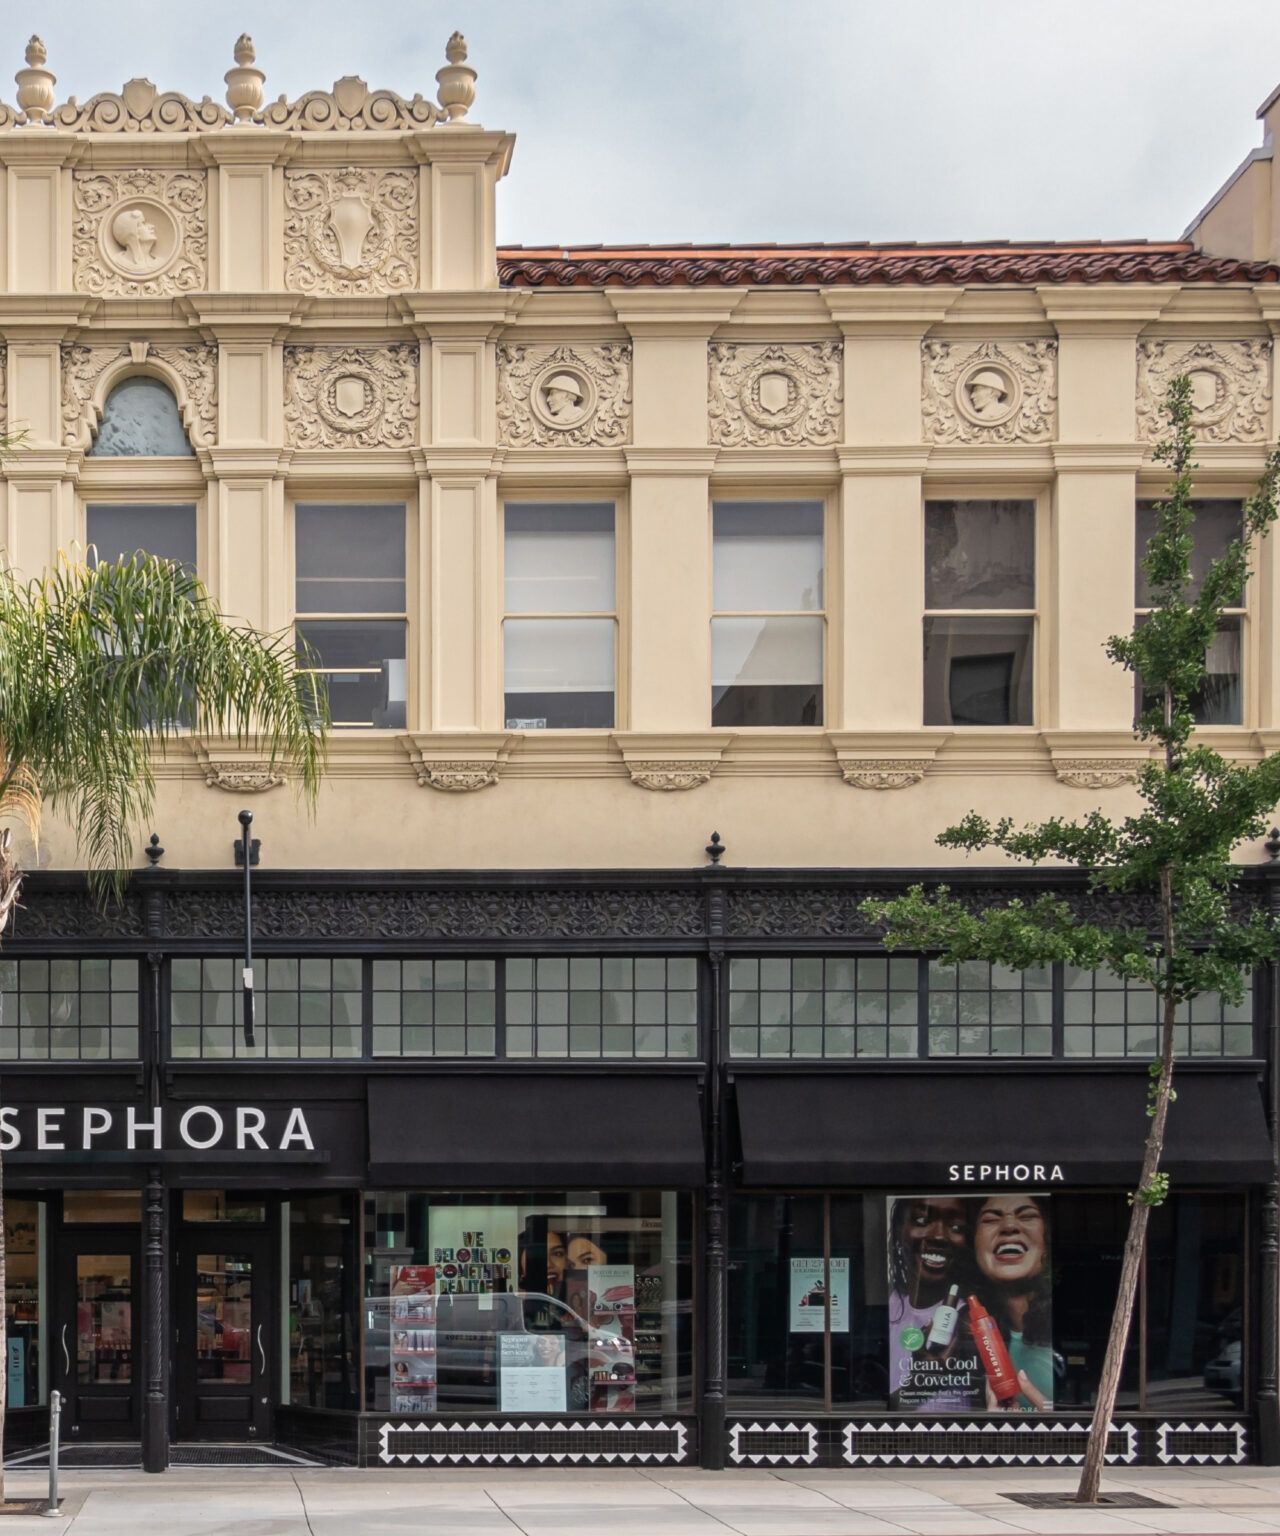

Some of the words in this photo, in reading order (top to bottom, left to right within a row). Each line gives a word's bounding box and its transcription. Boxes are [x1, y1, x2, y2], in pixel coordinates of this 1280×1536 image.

[0, 1104, 315, 1151] SEPHORA
[948, 1164, 1065, 1181] SEPHORA
[462, 1231, 484, 1248] WE
[433, 1247, 488, 1264] BELONG
[489, 1247, 512, 1264] TO
[435, 1264, 512, 1280] SOMETHING
[945, 1355, 978, 1371] Cool
[898, 1373, 912, 1387] &
[914, 1371, 971, 1387] Coveted
